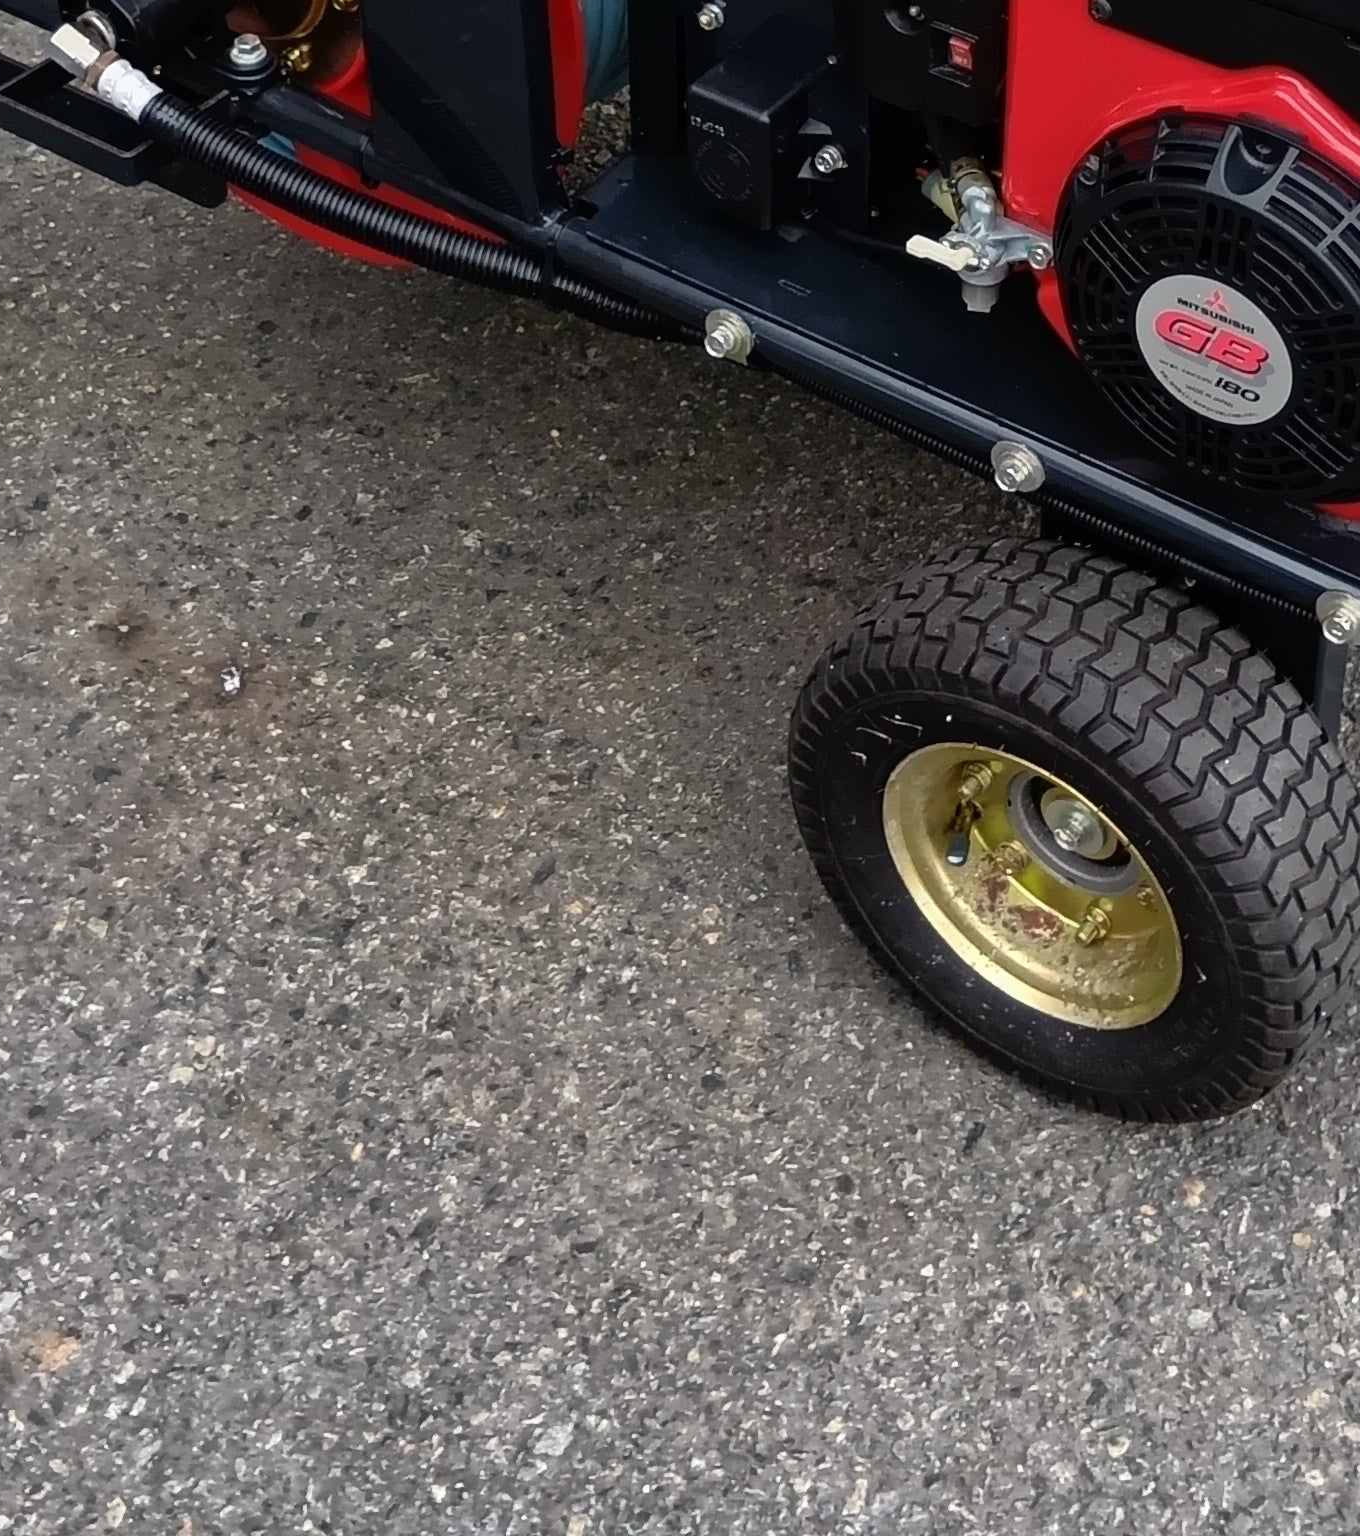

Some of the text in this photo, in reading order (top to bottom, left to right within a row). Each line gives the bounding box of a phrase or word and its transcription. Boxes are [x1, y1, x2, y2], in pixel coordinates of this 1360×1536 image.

[1176, 297, 1255, 335] MITSUBISHI
[1153, 310, 1272, 378] GB
[1214, 376, 1261, 403] 180
